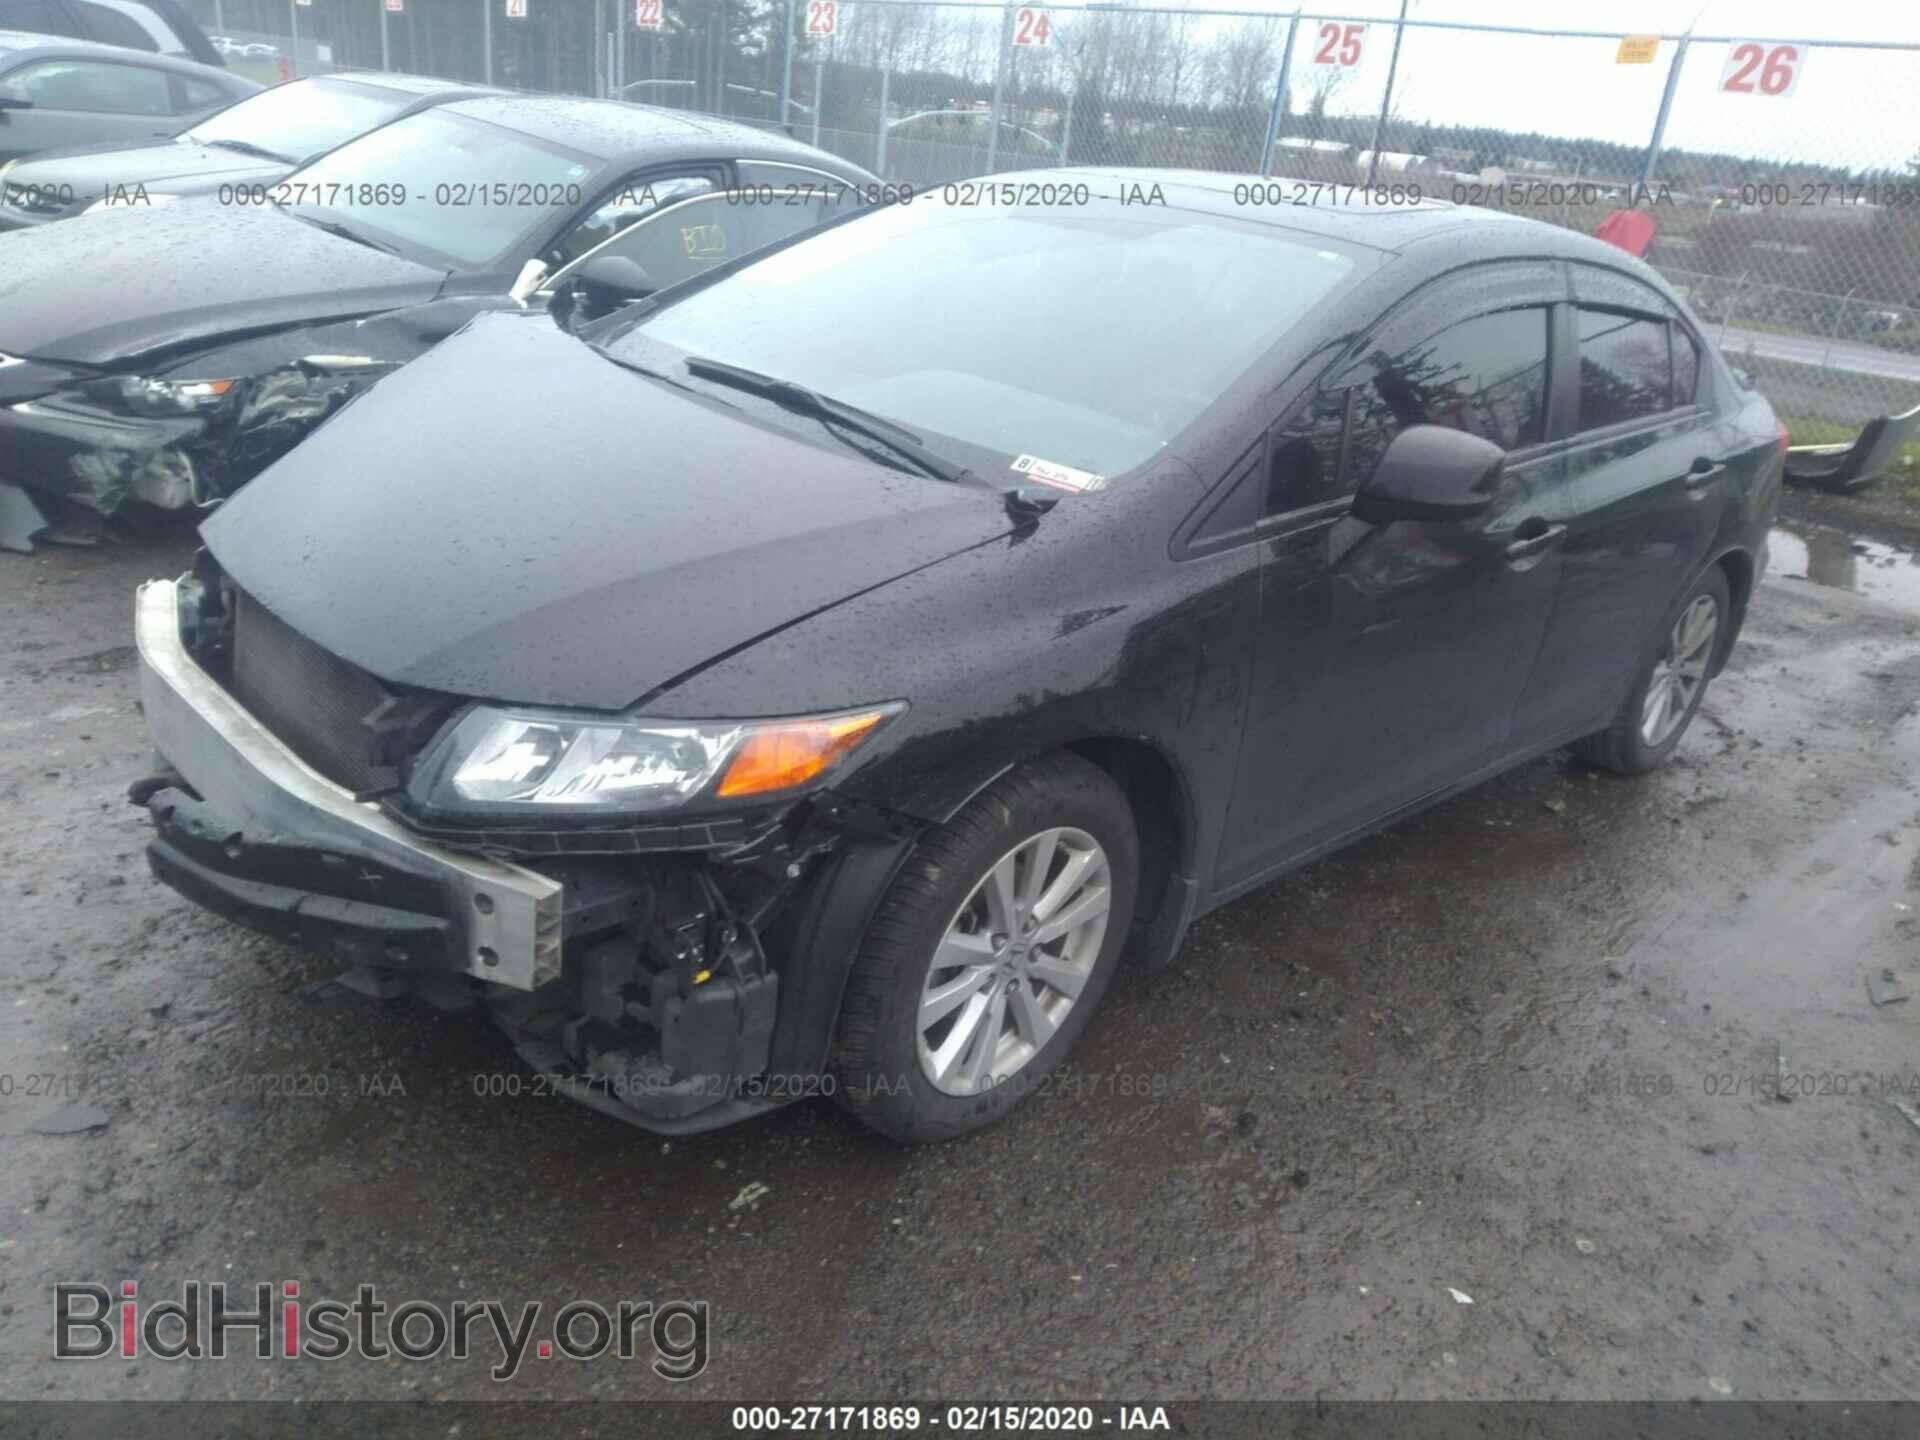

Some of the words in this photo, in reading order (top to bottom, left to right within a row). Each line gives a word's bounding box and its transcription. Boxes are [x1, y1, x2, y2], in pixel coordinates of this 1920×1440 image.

[640, 0, 658, 24] 22
[809, 2, 836, 33] 23
[1016, 9, 1049, 45] 24
[1315, 23, 1364, 66] 25
[1723, 43, 1798, 95] 26
